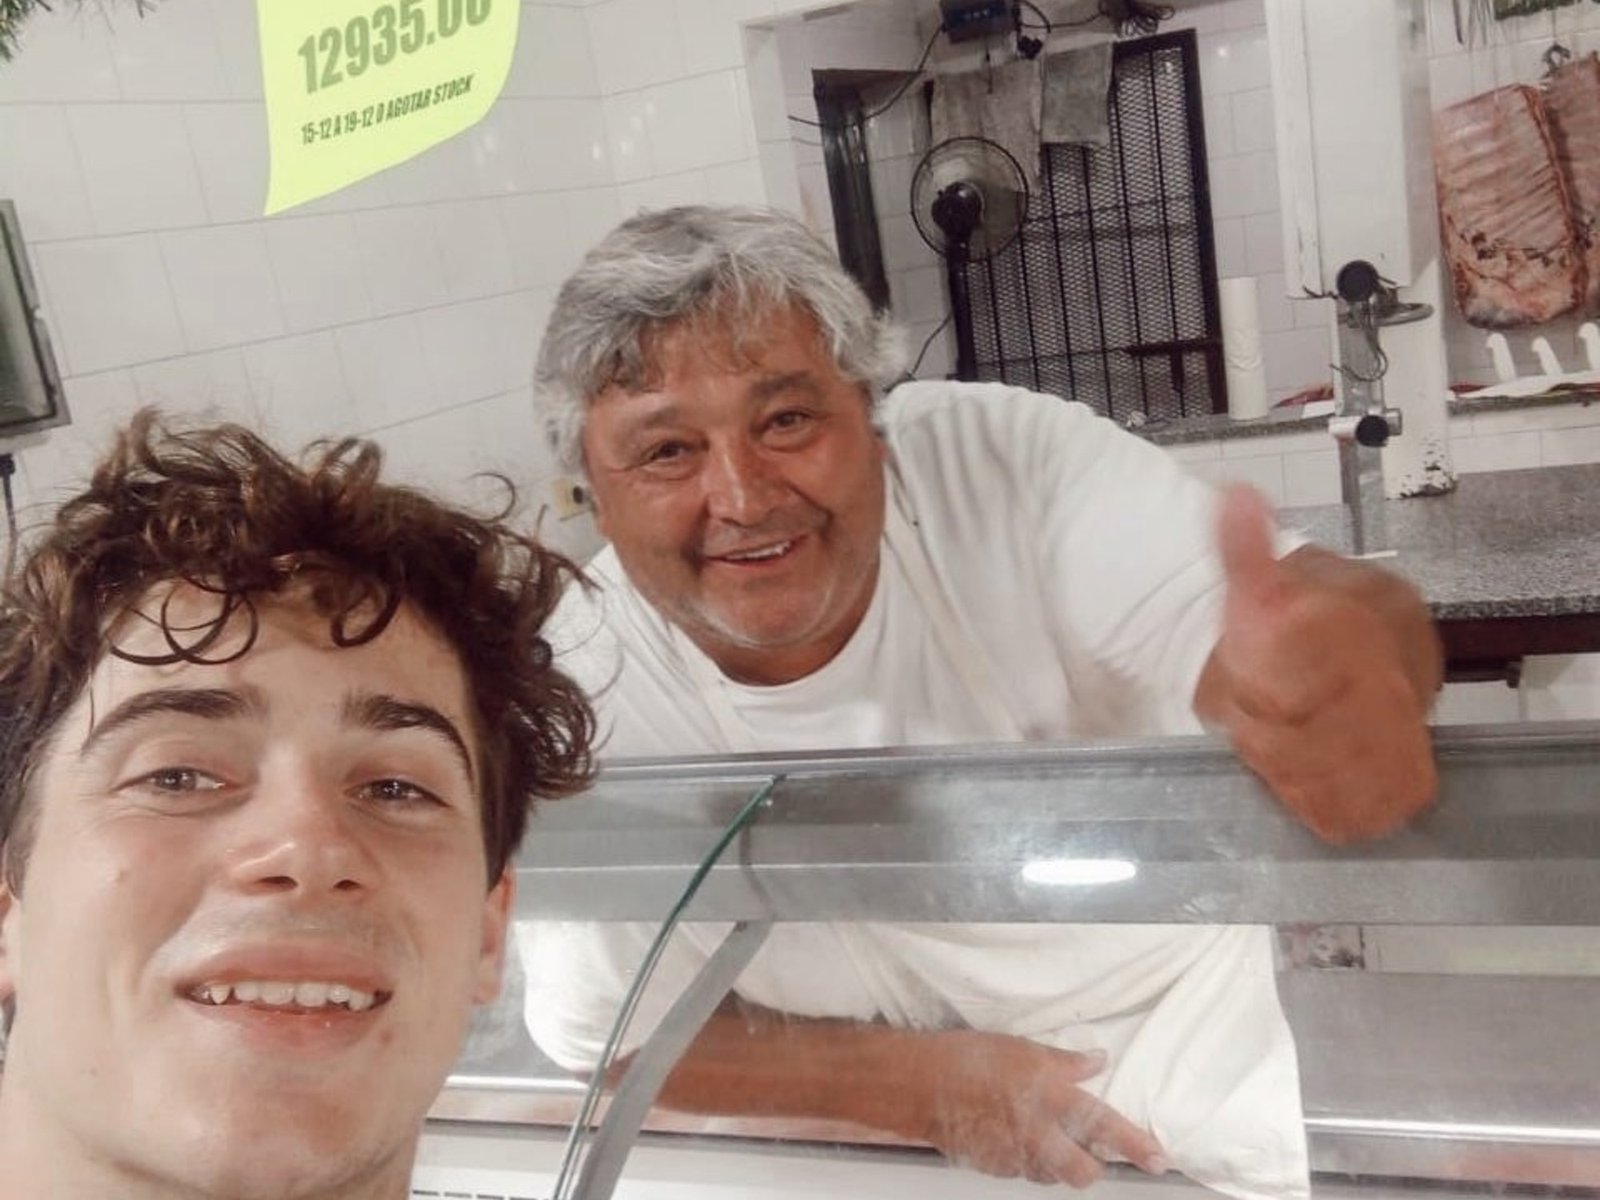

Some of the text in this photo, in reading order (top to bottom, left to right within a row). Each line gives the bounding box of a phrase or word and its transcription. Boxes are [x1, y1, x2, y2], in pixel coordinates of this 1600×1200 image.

[301, 117, 332, 145] 15-12
[333, 114, 342, 138] A
[344, 105, 374, 134] 19-12
[386, 88, 432, 121] AGOTAR
[432, 73, 475, 106] STOCK
